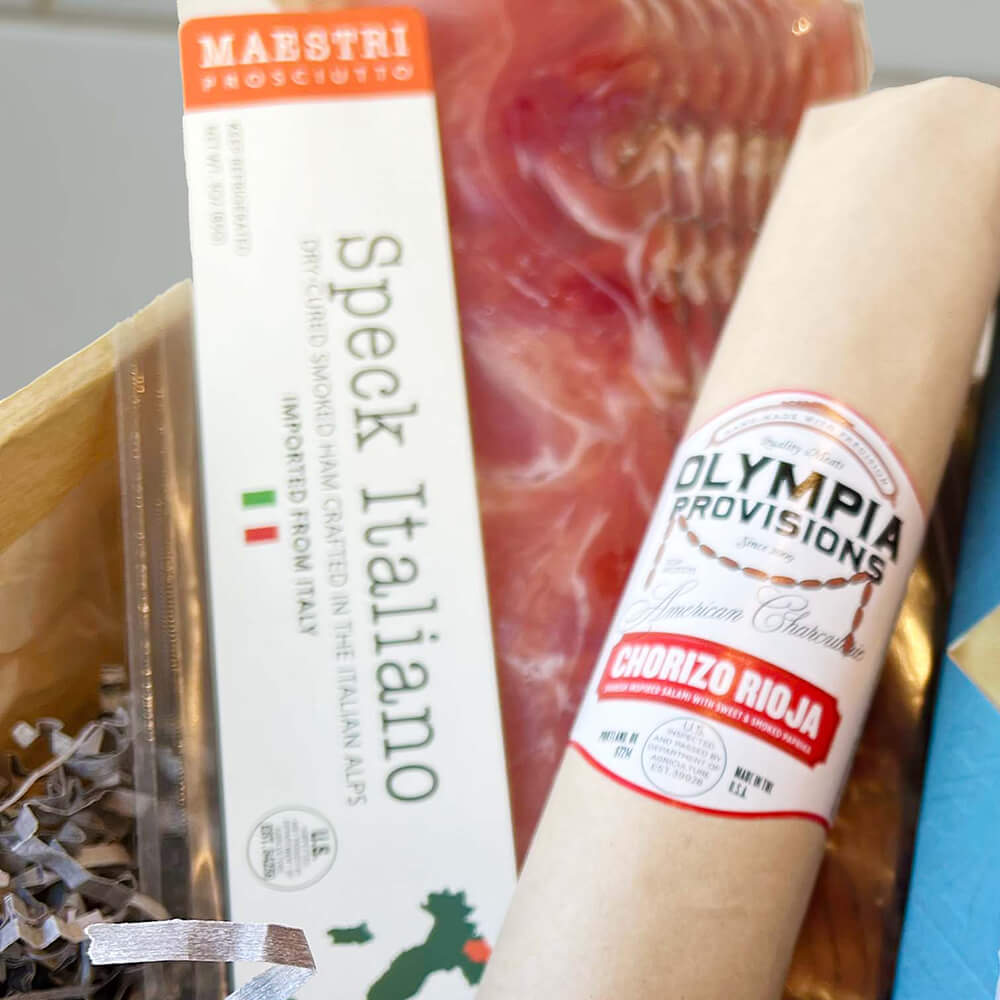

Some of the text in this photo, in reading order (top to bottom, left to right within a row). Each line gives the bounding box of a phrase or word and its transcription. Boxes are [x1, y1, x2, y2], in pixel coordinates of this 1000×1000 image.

[197, 22, 411, 69] MAESTRI
[201, 64, 414, 92] PROSCIUTTO
[318, 443, 340, 492] HAM
[281, 395, 319, 637] IMPORTED FROM ITALY
[327, 235, 440, 803] Speck Italiano
[674, 452, 904, 564] OLYMPIA
[321, 498, 349, 588] CRAFTED
[670, 495, 887, 584] PROVISIONS
[331, 594, 351, 616] IN
[624, 579, 744, 632] American
[334, 621, 355, 661] THE
[336, 667, 362, 749] ITALIAN
[610, 644, 823, 740] CHORIZO RIOJA
[660, 686, 692, 702] SALAMI
[691, 693, 715, 710] WITH
[714, 702, 744, 721] SWEET
[742, 711, 751, 724] &
[750, 716, 783, 739] SMOKED
[344, 754, 367, 807] ALPS
[733, 765, 754, 784] MADE
